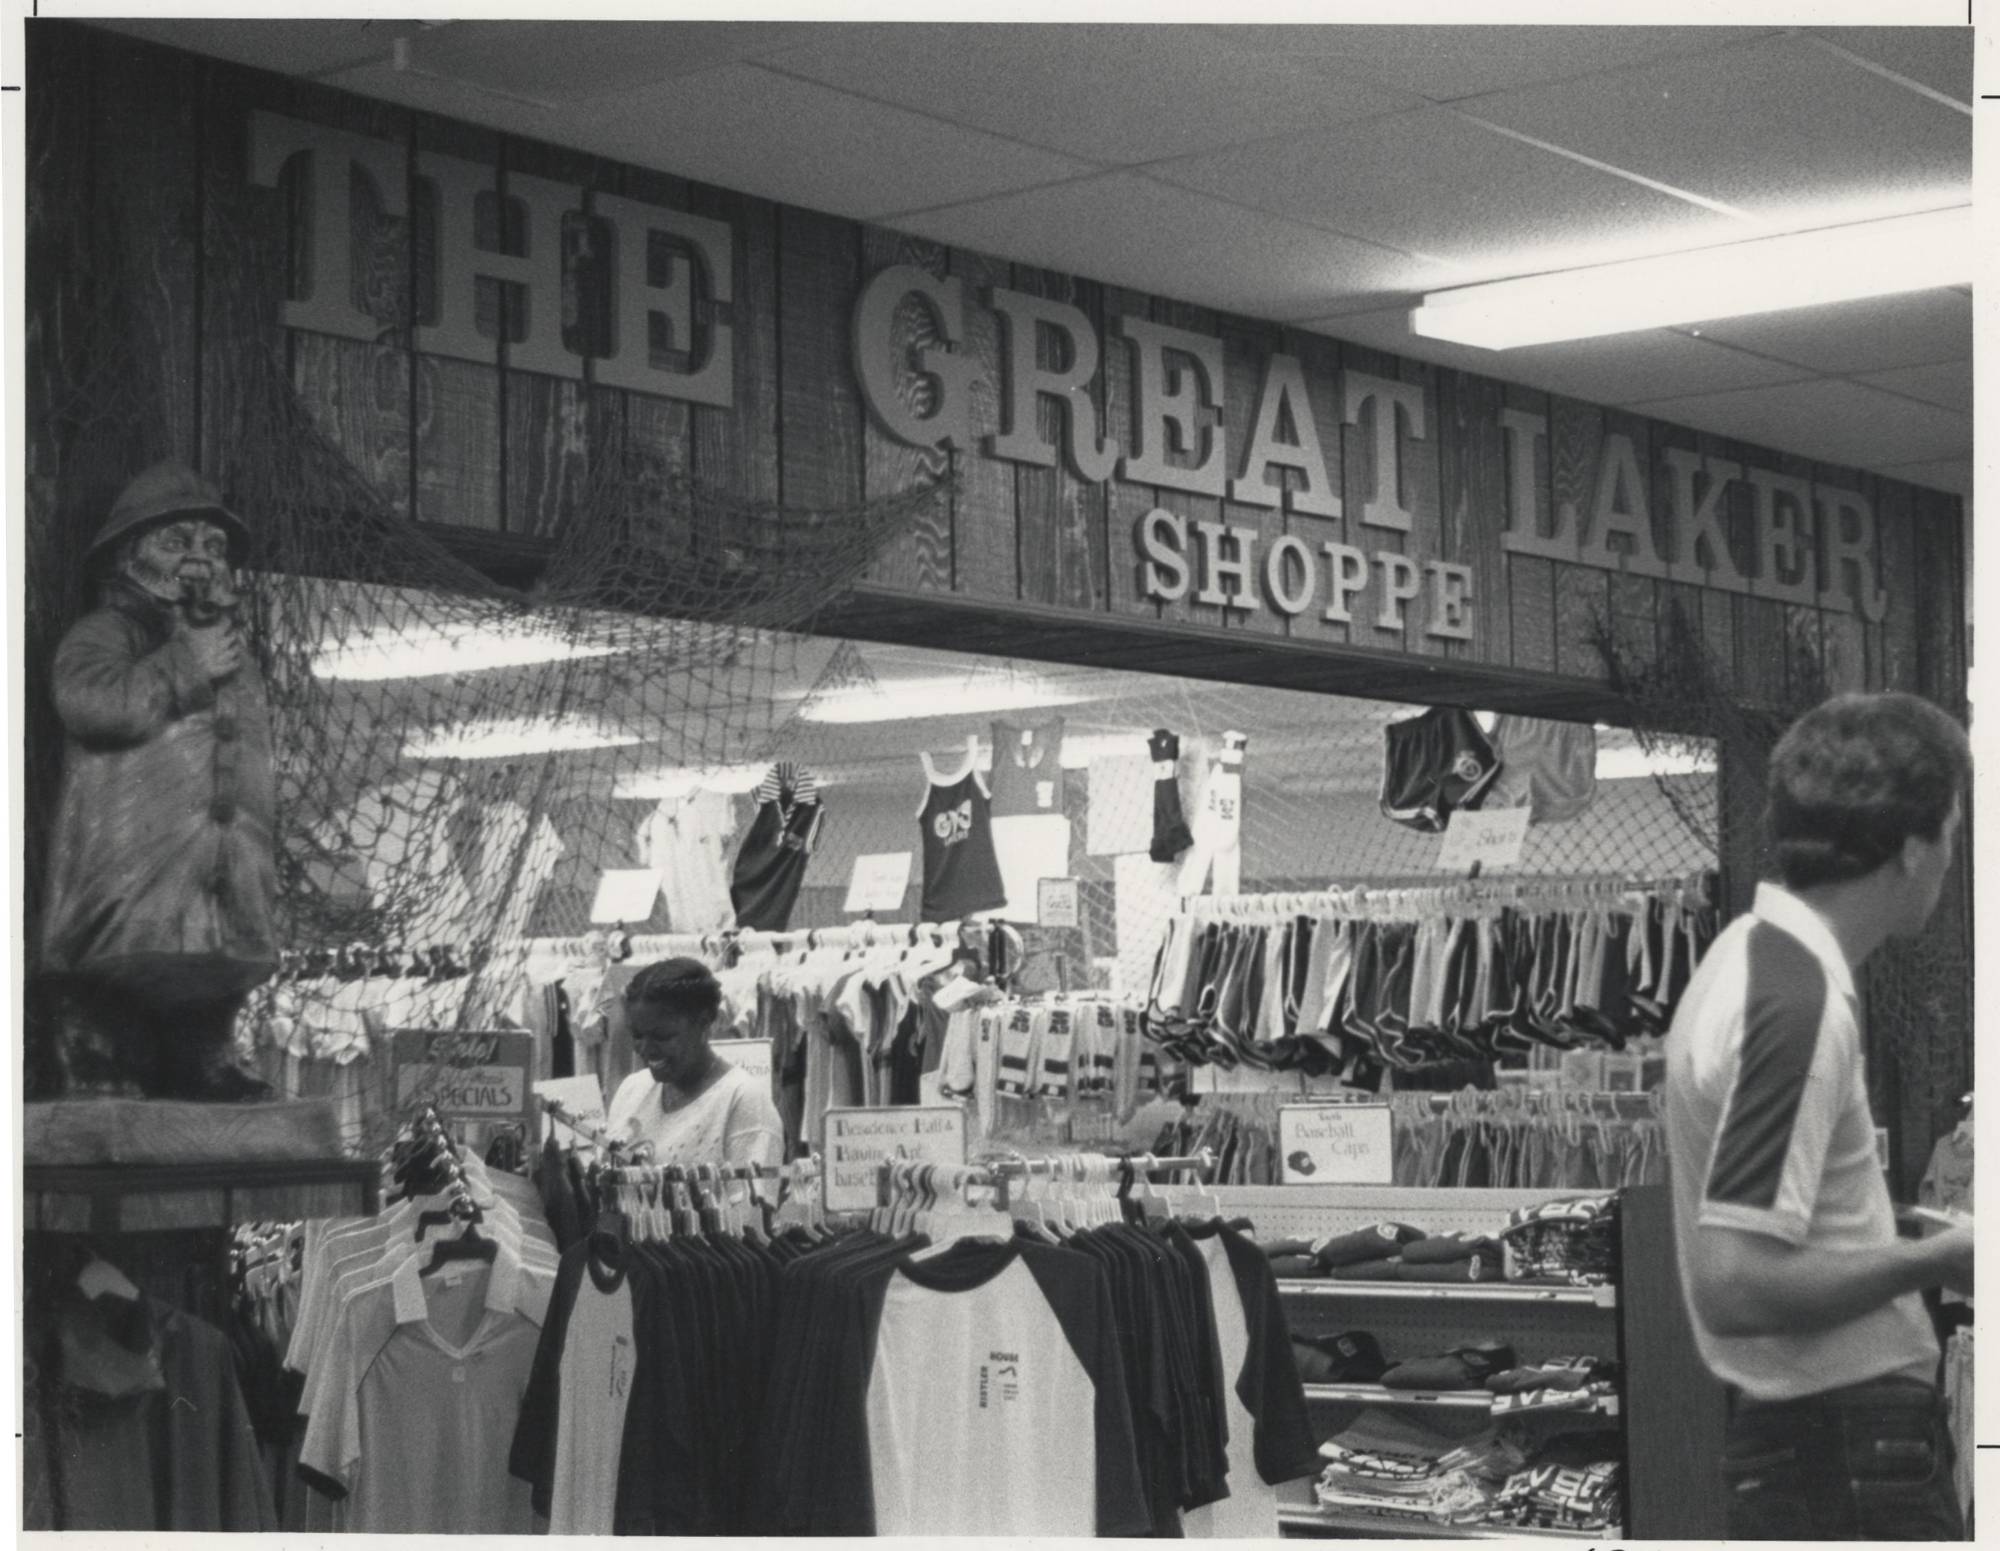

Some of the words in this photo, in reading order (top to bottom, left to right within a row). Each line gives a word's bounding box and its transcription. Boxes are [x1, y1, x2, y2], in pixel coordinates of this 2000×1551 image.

[248, 109, 733, 408] THE
[858, 264, 1424, 532] GREAT
[1501, 408, 1888, 624] LAKER
[1141, 507, 1473, 640] SHOPPE
[1294, 1122, 1355, 1139] Baseball
